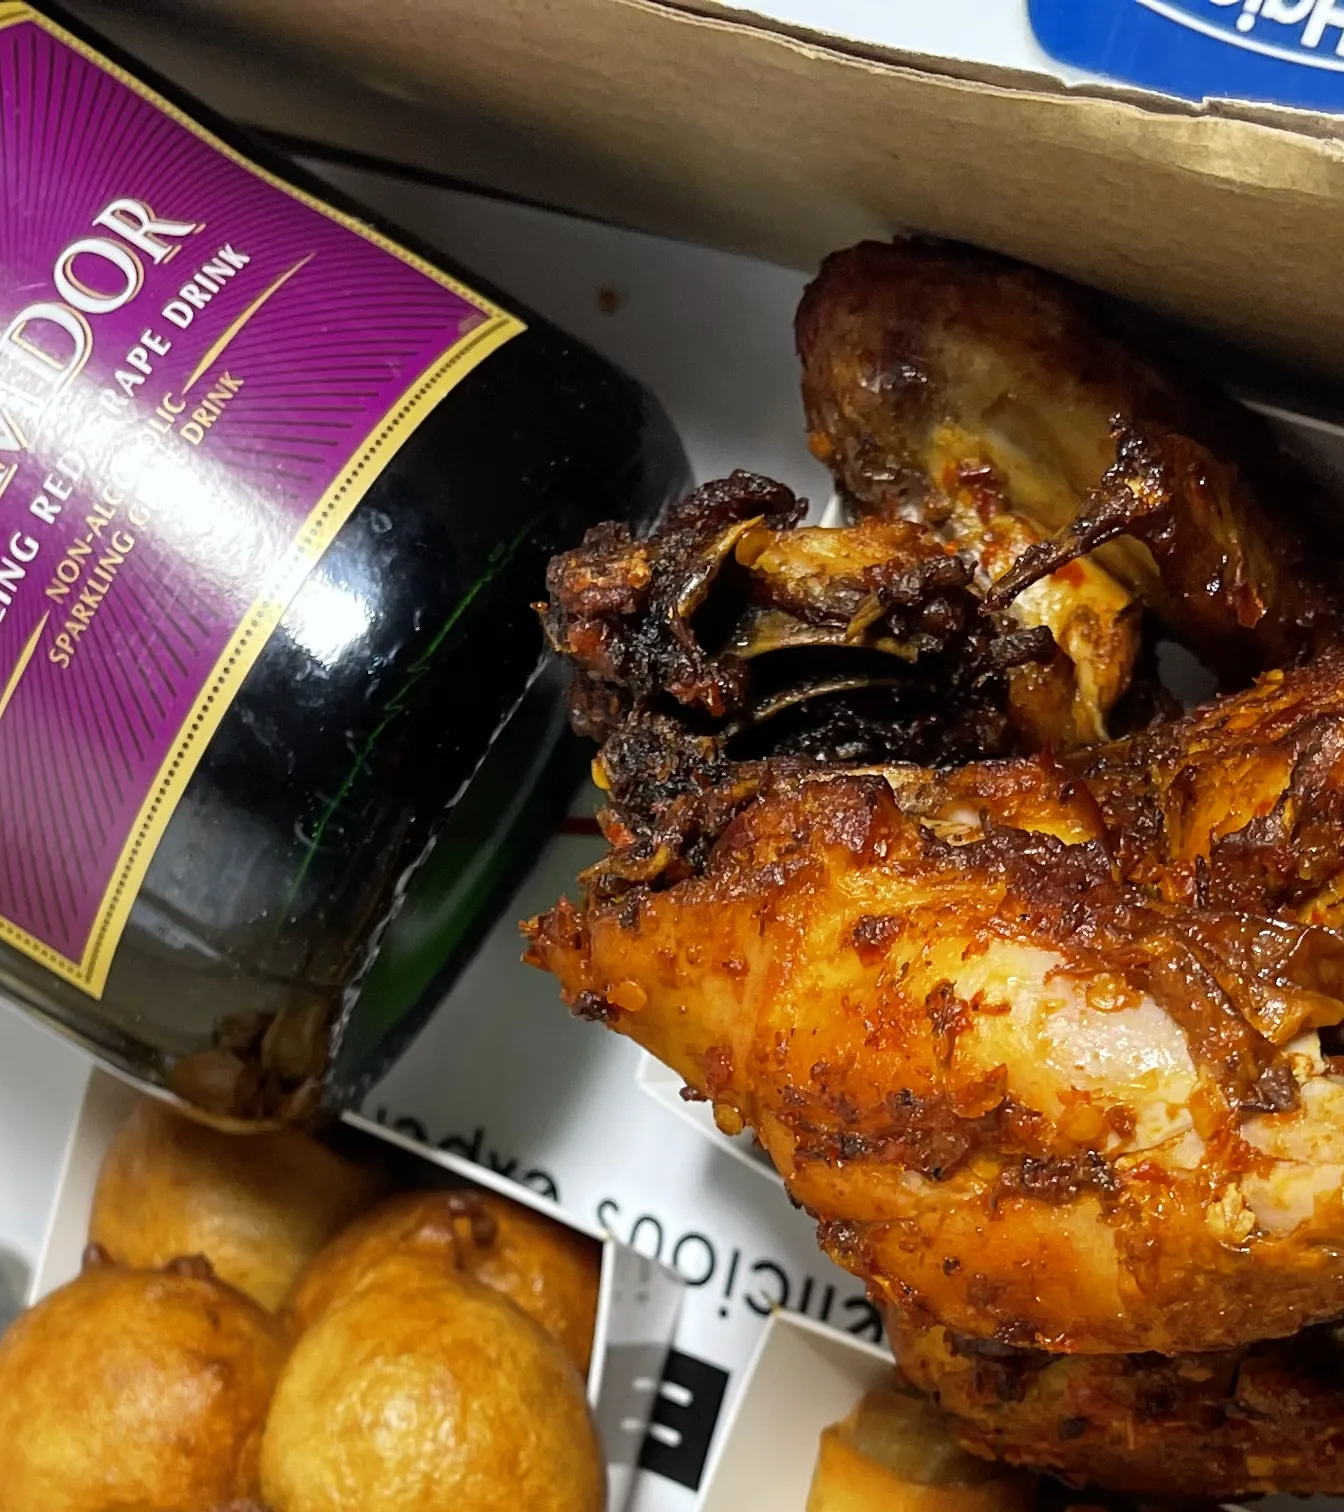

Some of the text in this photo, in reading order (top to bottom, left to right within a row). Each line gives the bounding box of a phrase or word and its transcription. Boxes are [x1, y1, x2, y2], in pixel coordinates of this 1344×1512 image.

[29, 446, 86, 525] RED
[96, 327, 172, 424] RAPE
[161, 243, 251, 330] DRINK
[45, 391, 187, 603] NON-ALCOLIC
[48, 370, 245, 669] SPARKLING DRINK
